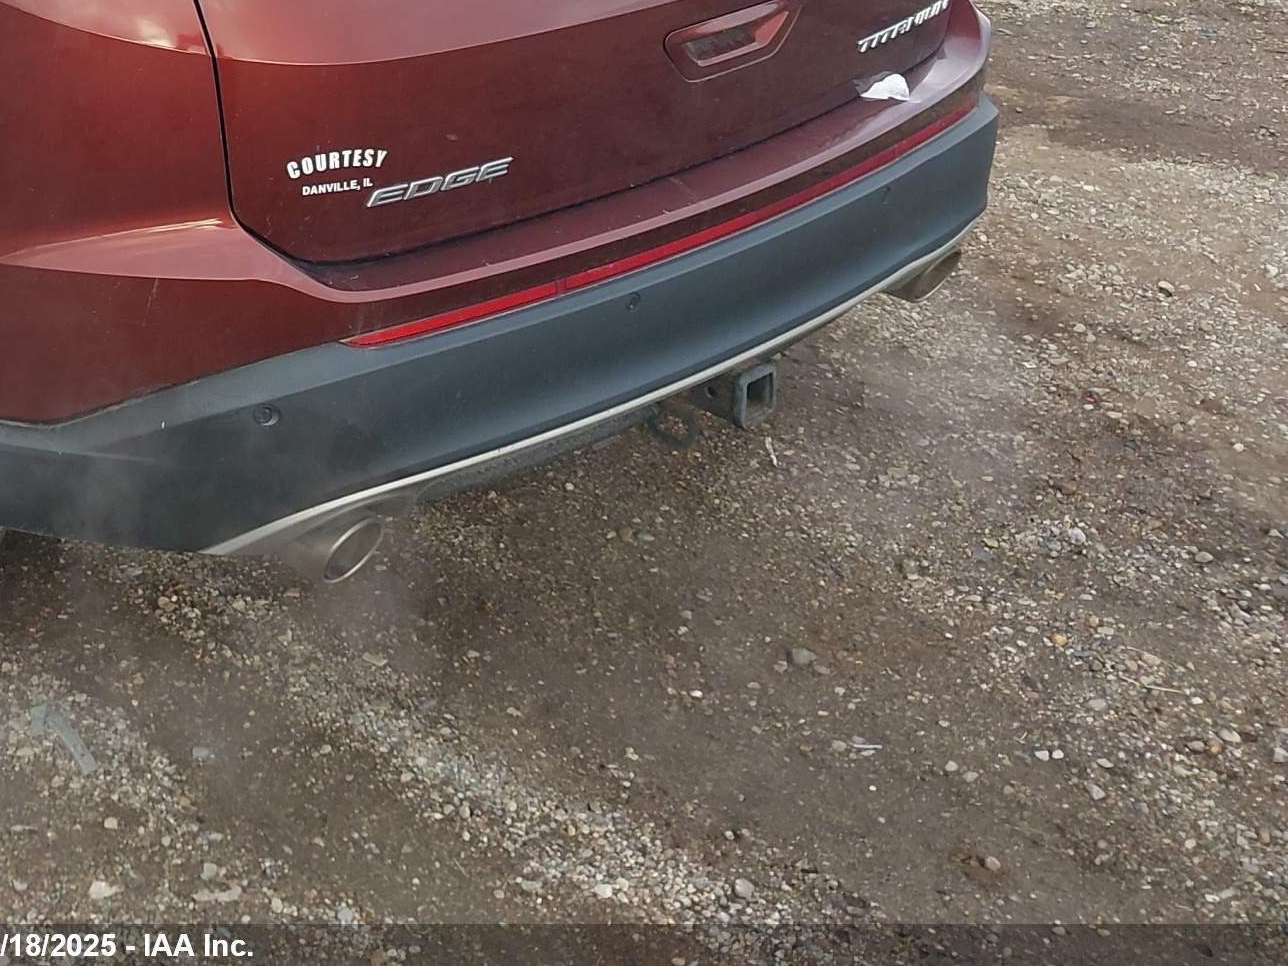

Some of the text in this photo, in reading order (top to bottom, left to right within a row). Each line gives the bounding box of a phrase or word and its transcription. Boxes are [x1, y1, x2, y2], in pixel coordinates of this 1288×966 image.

[286, 148, 389, 179] COURTESY
[302, 177, 374, 196] DANVILLE, IL
[365, 156, 514, 208] EDGE
